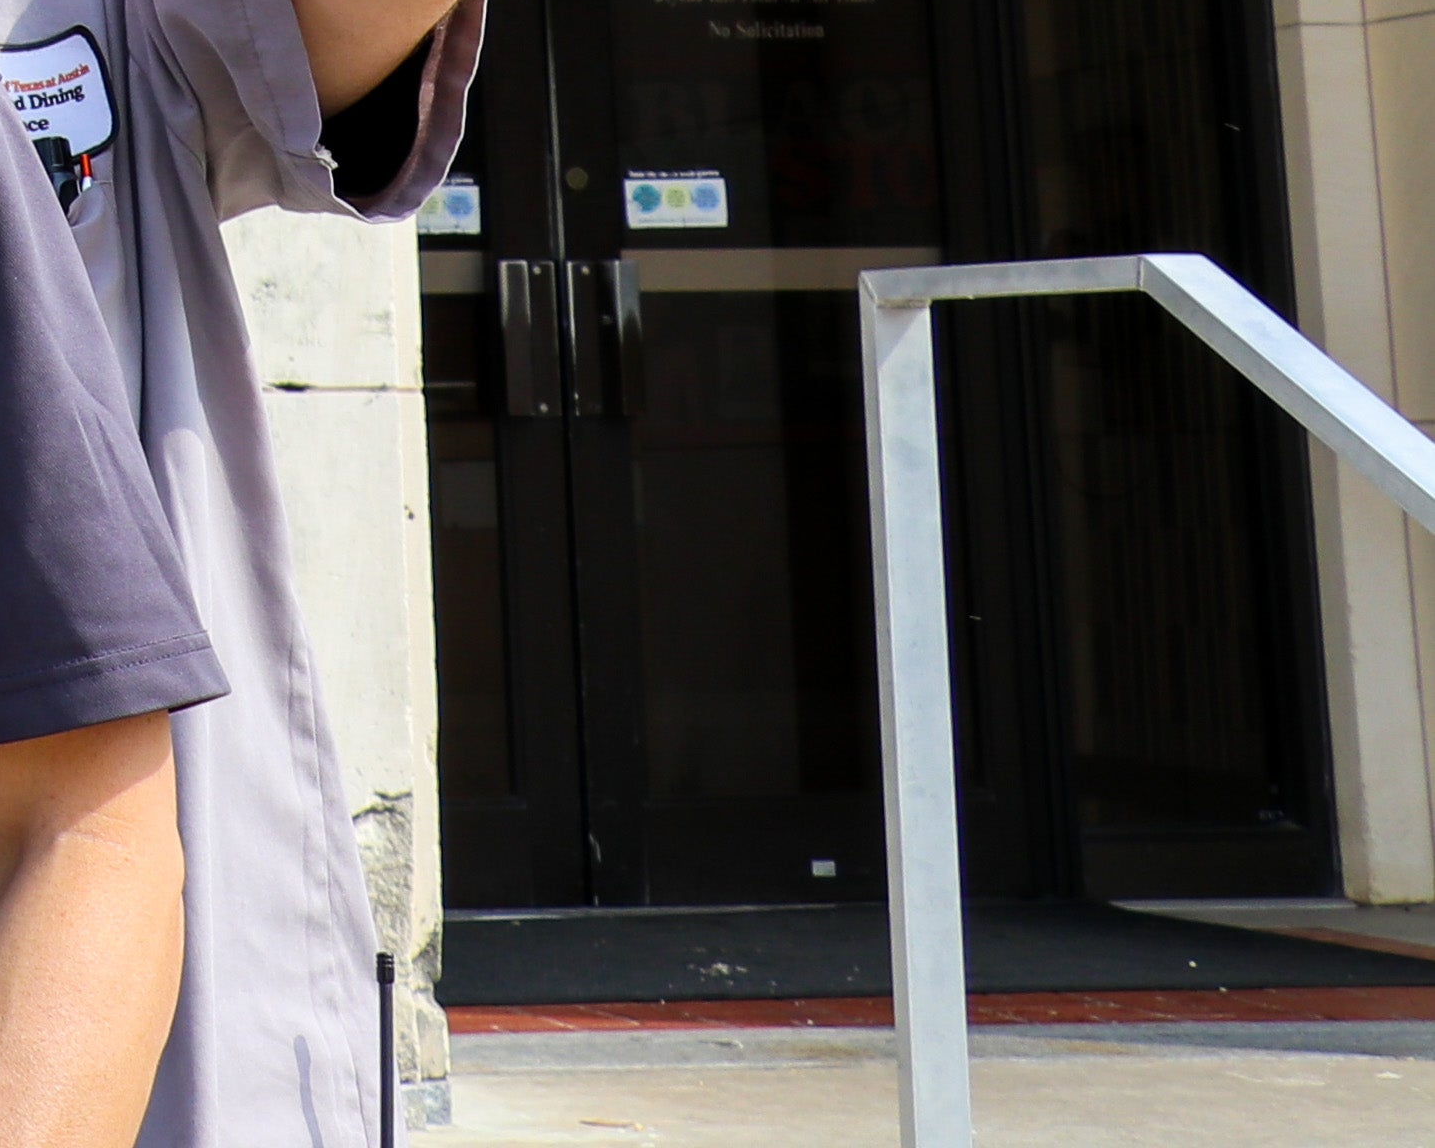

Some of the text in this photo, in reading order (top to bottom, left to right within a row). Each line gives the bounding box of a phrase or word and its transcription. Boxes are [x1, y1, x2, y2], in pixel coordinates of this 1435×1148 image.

[708, 20, 825, 39] No Solicitation
[11, 80, 45, 92] Texas
[45, 77, 57, 88] at
[58, 63, 90, 85] Austin
[28, 84, 85, 110] Dining
